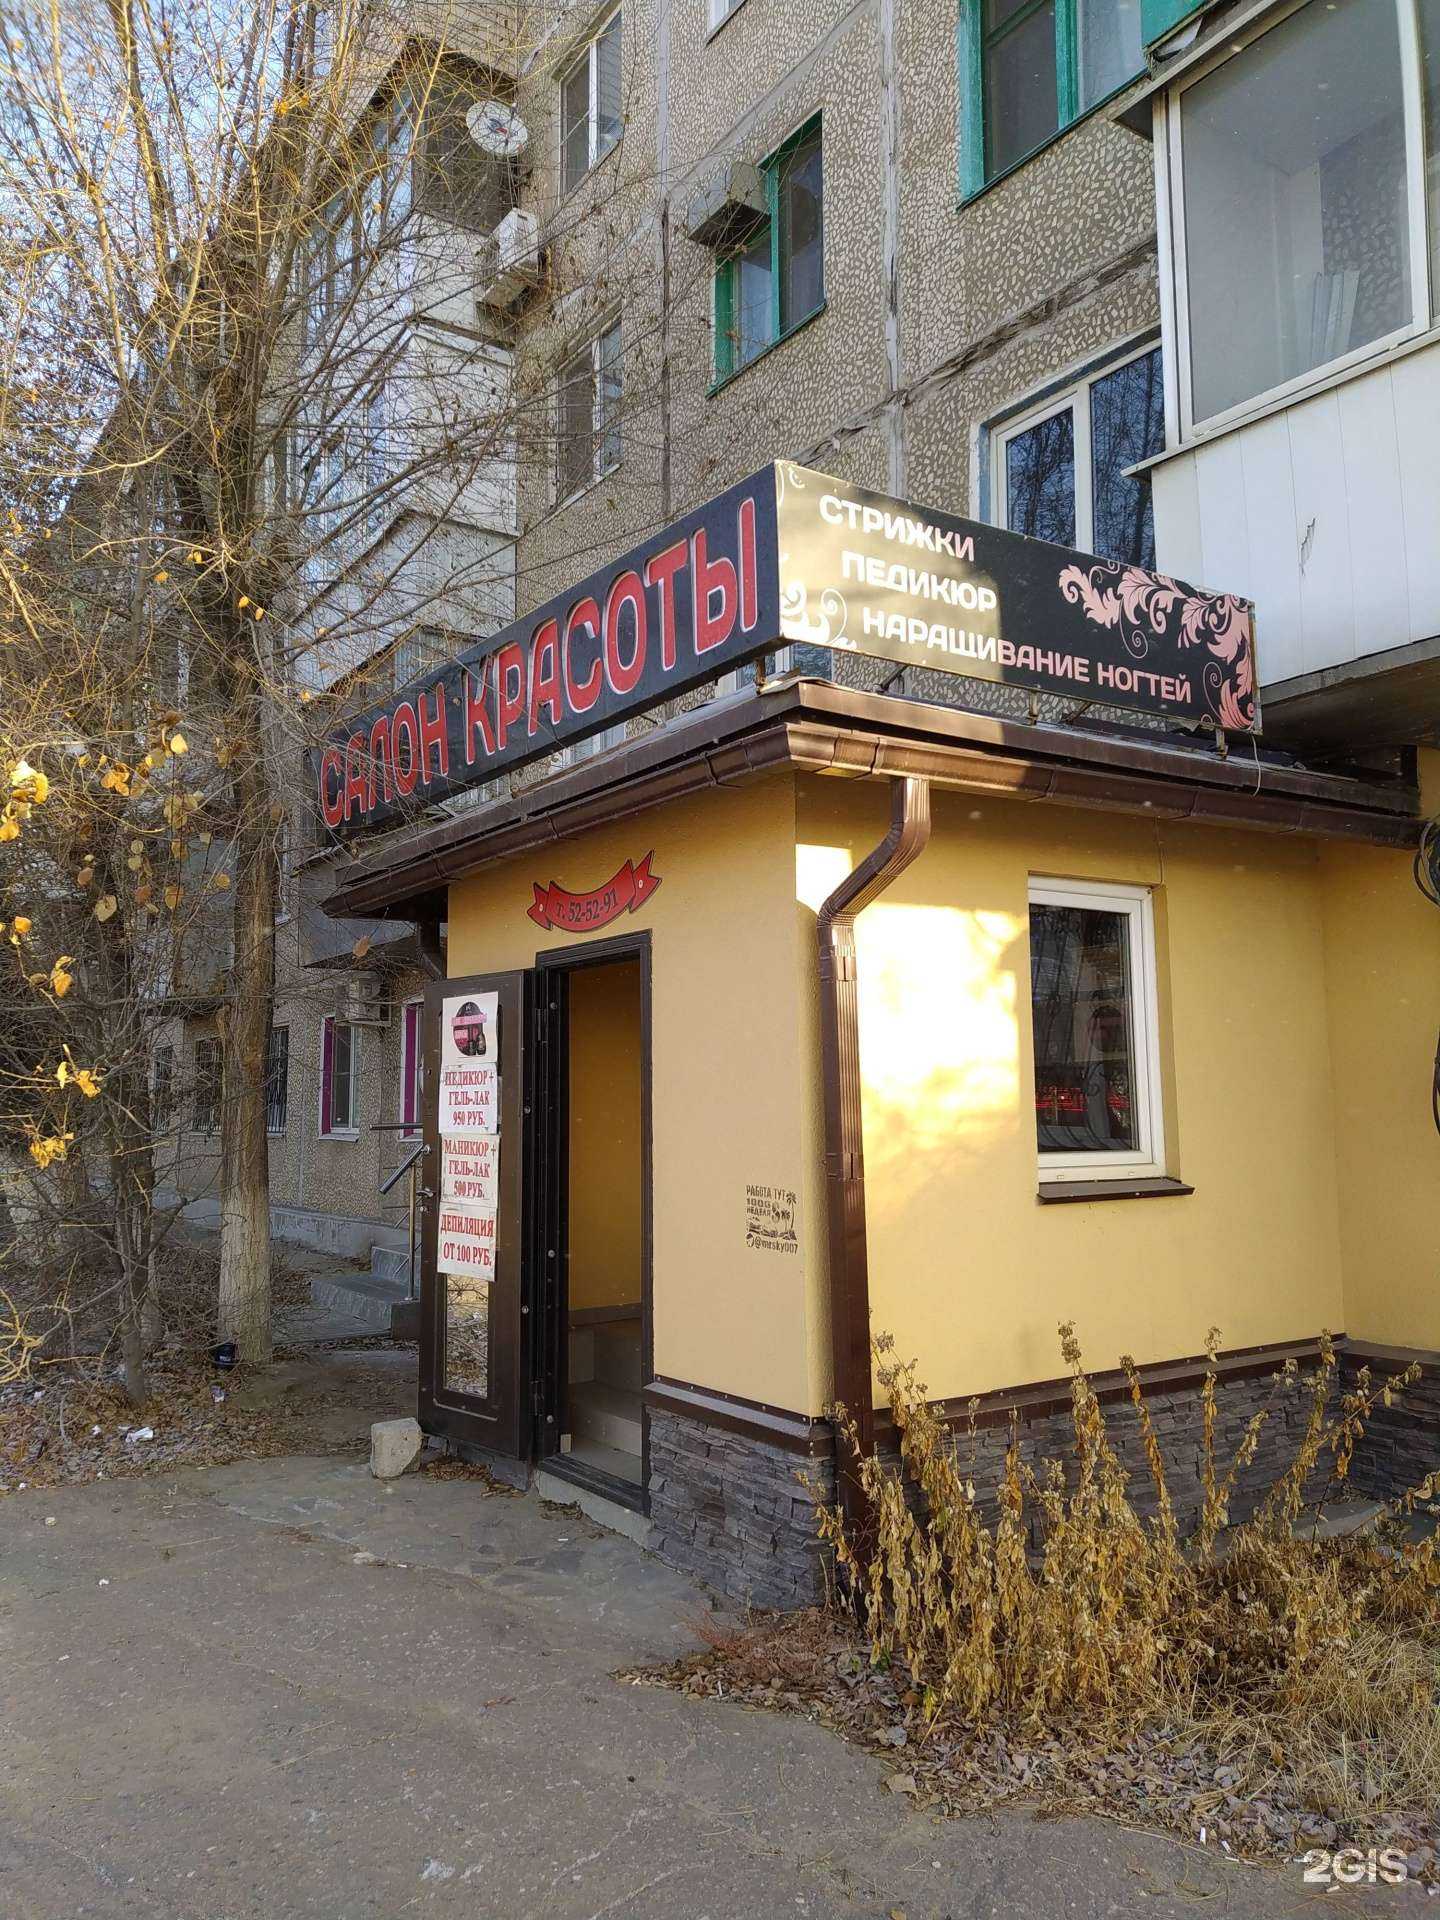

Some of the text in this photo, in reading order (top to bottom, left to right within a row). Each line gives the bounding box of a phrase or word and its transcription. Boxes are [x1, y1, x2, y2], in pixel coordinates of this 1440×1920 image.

[819, 495, 974, 562] СТРИЖКИ
[841, 551, 998, 611] ПЕДИКЮР
[320, 497, 758, 827] САЛОН КРАСОТЫ
[863, 607, 1192, 704] НАРАЩИВАНИЕ НОГТЕЙ
[568, 888, 617, 922] 52-52-91
[445, 1071, 488, 1087] ПЕДИКЮР
[448, 1091, 490, 1105] ГЕЛЬ-ЛАК
[453, 1111, 486, 1125] 950 РУБ.
[444, 1139, 489, 1157] МАНИКЮР
[448, 1160, 490, 1178] ГЕЛЬ-ЛАК
[467, 1182, 485, 1198] РУБ.
[746, 1185, 786, 1200] РАБОТА ТУТ
[441, 1214, 494, 1240] ДЕПИЛЯЦИЯ
[443, 1242, 492, 1266] ОТ 100 РУБ.
